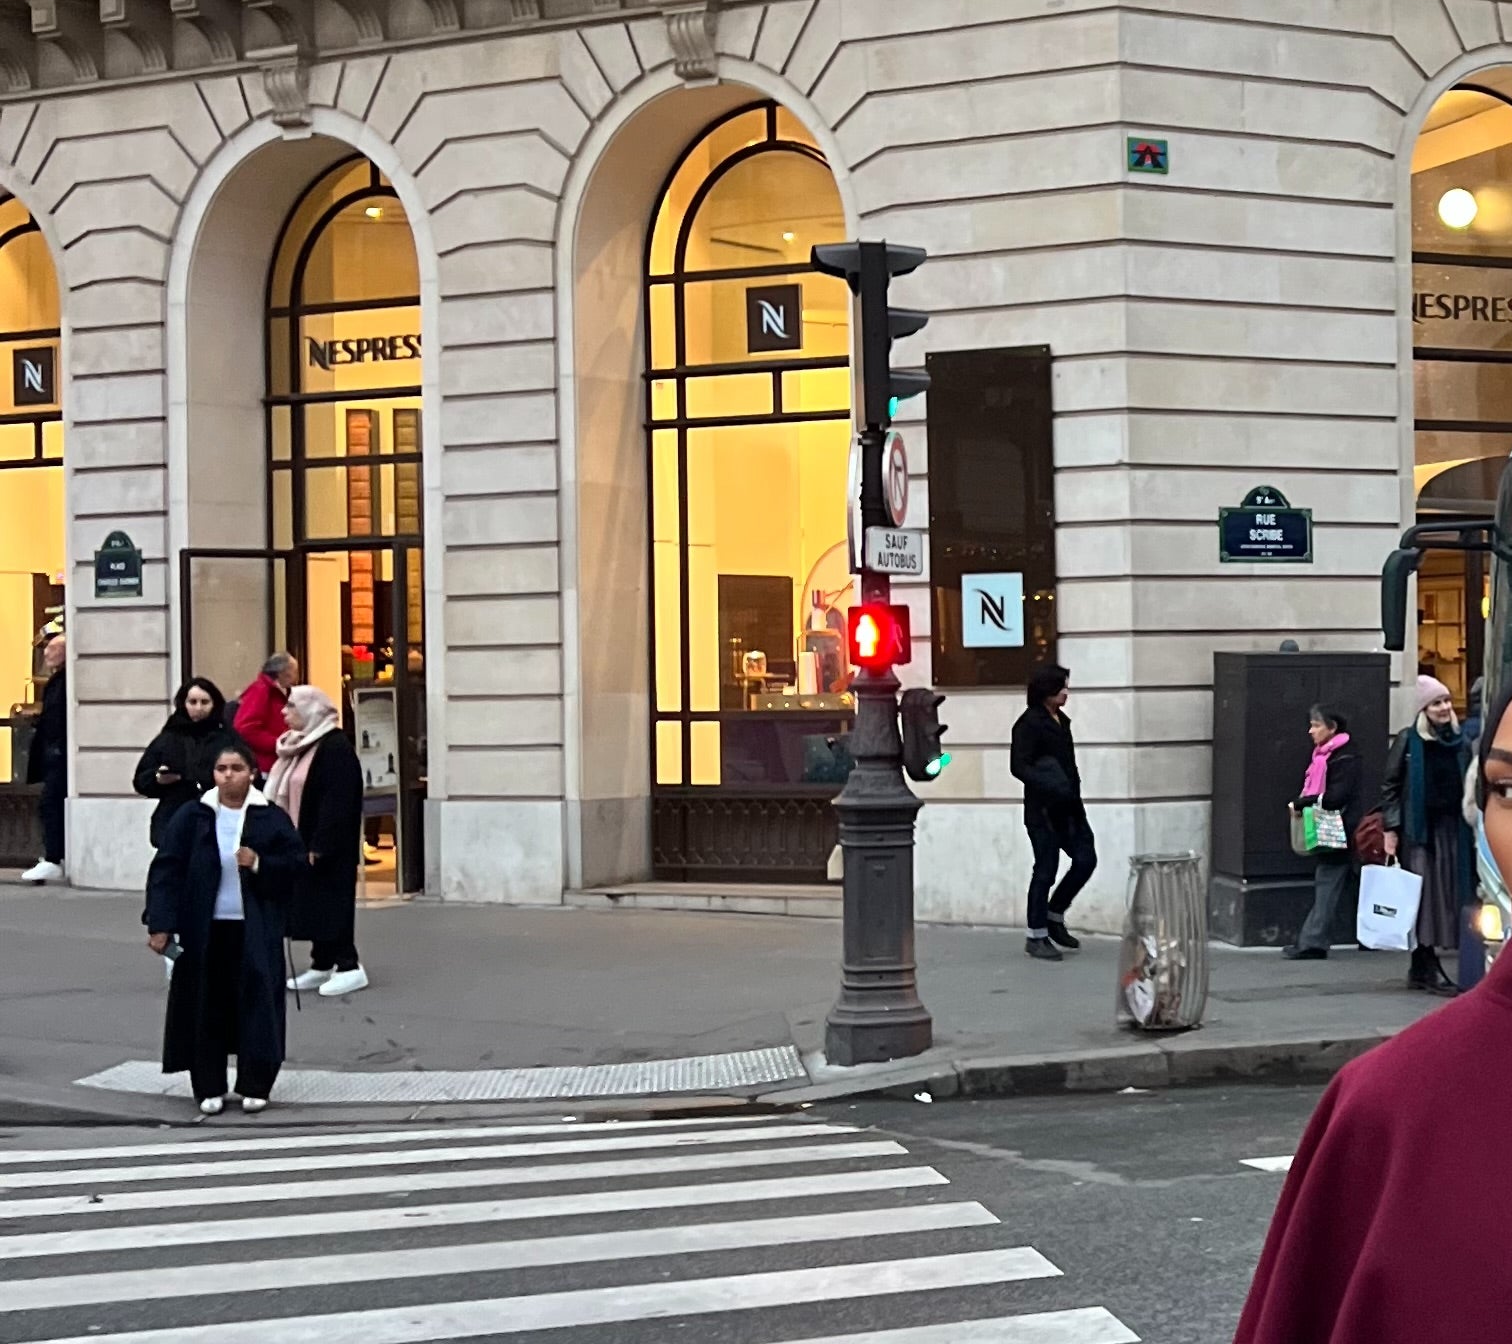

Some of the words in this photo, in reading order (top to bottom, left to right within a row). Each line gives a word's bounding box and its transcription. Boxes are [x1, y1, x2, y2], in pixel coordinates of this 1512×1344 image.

[757, 300, 790, 338] N
[21, 359, 46, 393] N
[1256, 513, 1277, 525] RUE
[885, 533, 908, 550] SAUF
[878, 551, 917, 570] AUTOBUS
[971, 588, 1013, 631] N
